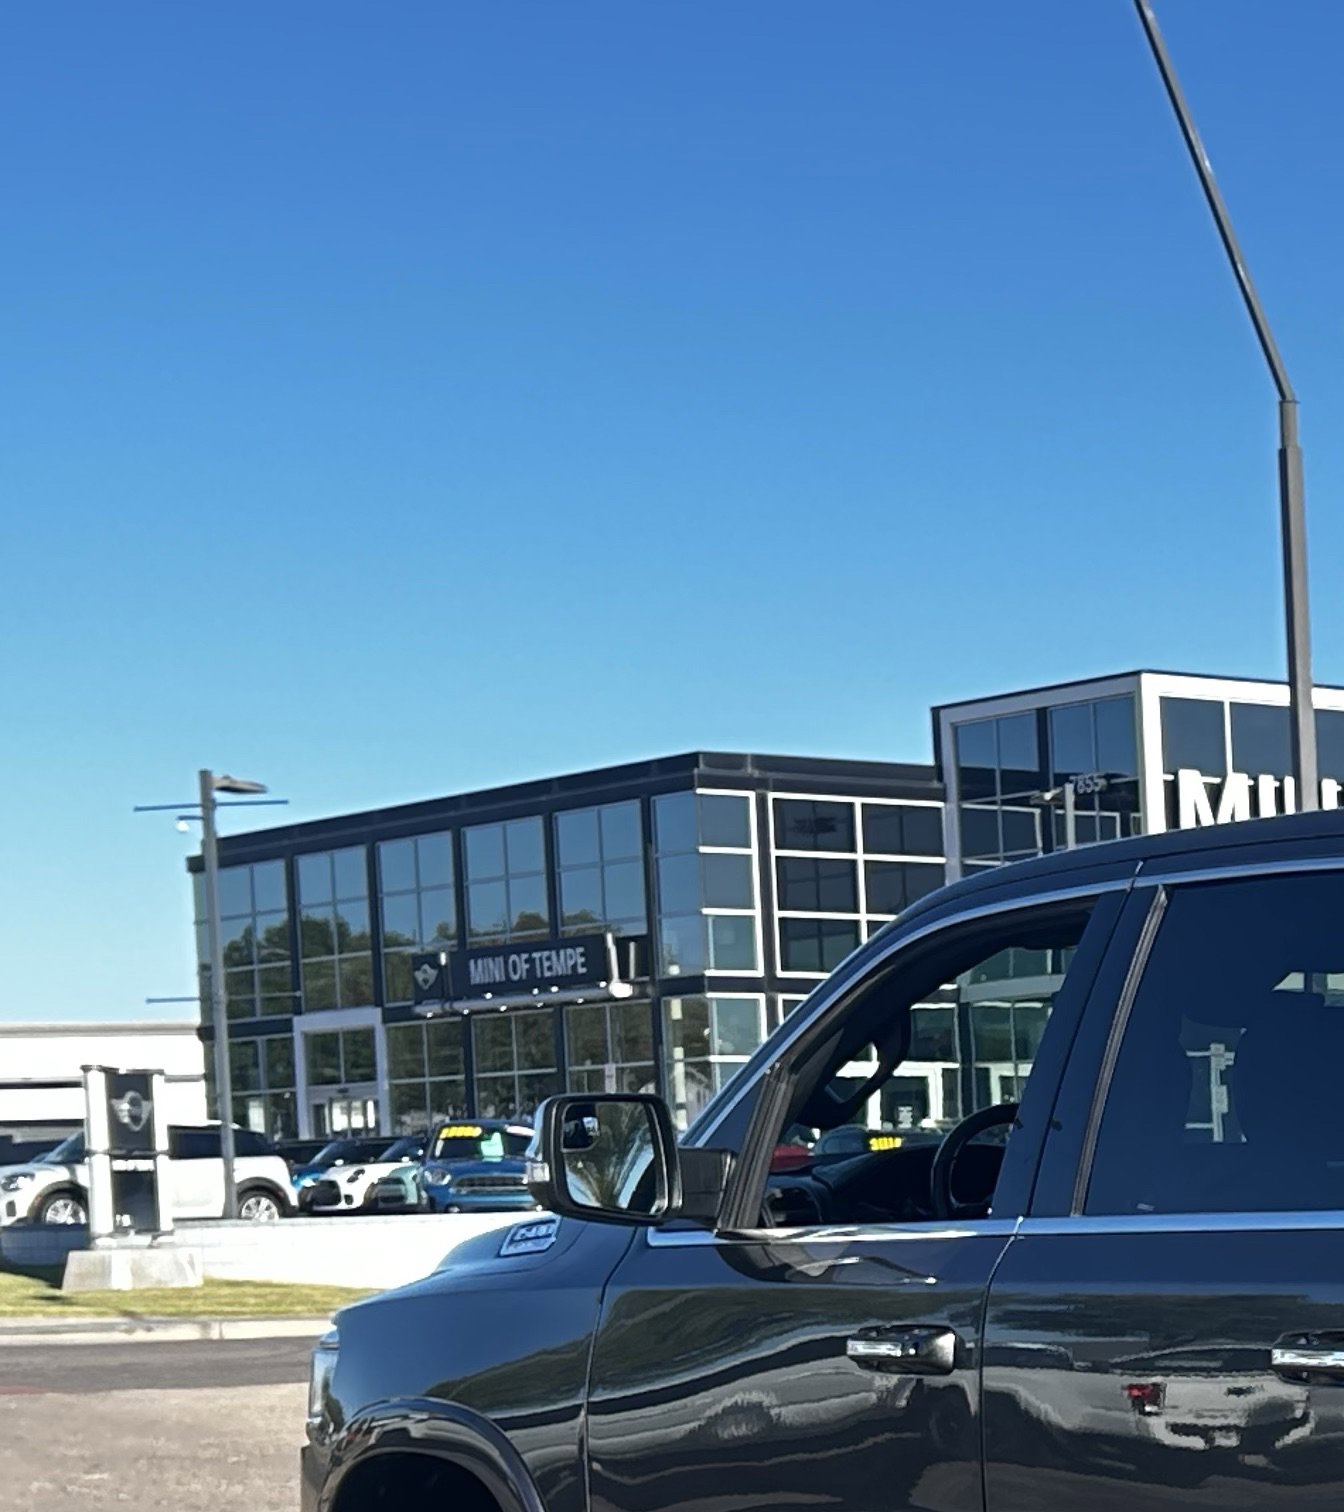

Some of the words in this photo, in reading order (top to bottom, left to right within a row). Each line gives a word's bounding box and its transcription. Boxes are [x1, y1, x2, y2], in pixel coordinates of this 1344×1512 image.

[469, 955, 505, 985] MINI
[508, 953, 531, 981] OF
[532, 947, 588, 978] TEMPE
